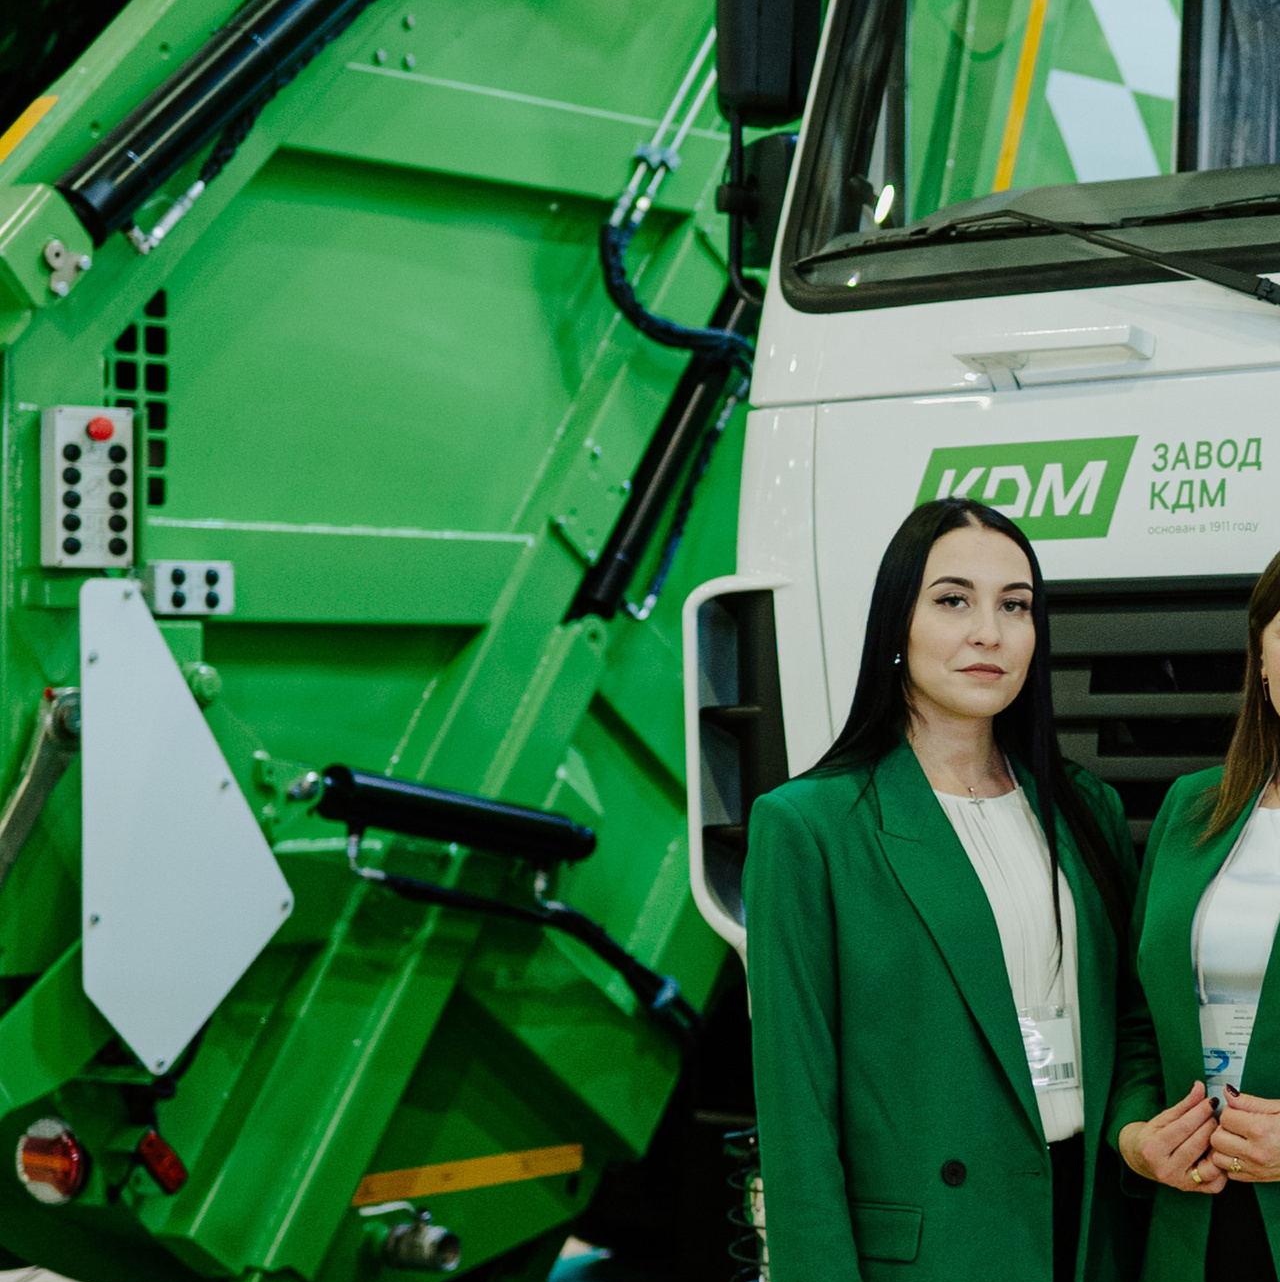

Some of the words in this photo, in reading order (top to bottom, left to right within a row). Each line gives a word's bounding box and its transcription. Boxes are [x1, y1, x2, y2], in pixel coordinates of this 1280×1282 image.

[1152, 437, 1262, 472] ЗАВОД
[935, 460, 1108, 519] KDM
[1150, 478, 1226, 513] КДМ
[1147, 524, 1196, 535] основан
[1199, 523, 1206, 533] в
[1209, 521, 1231, 532] 1911
[1232, 521, 1259, 533] году
